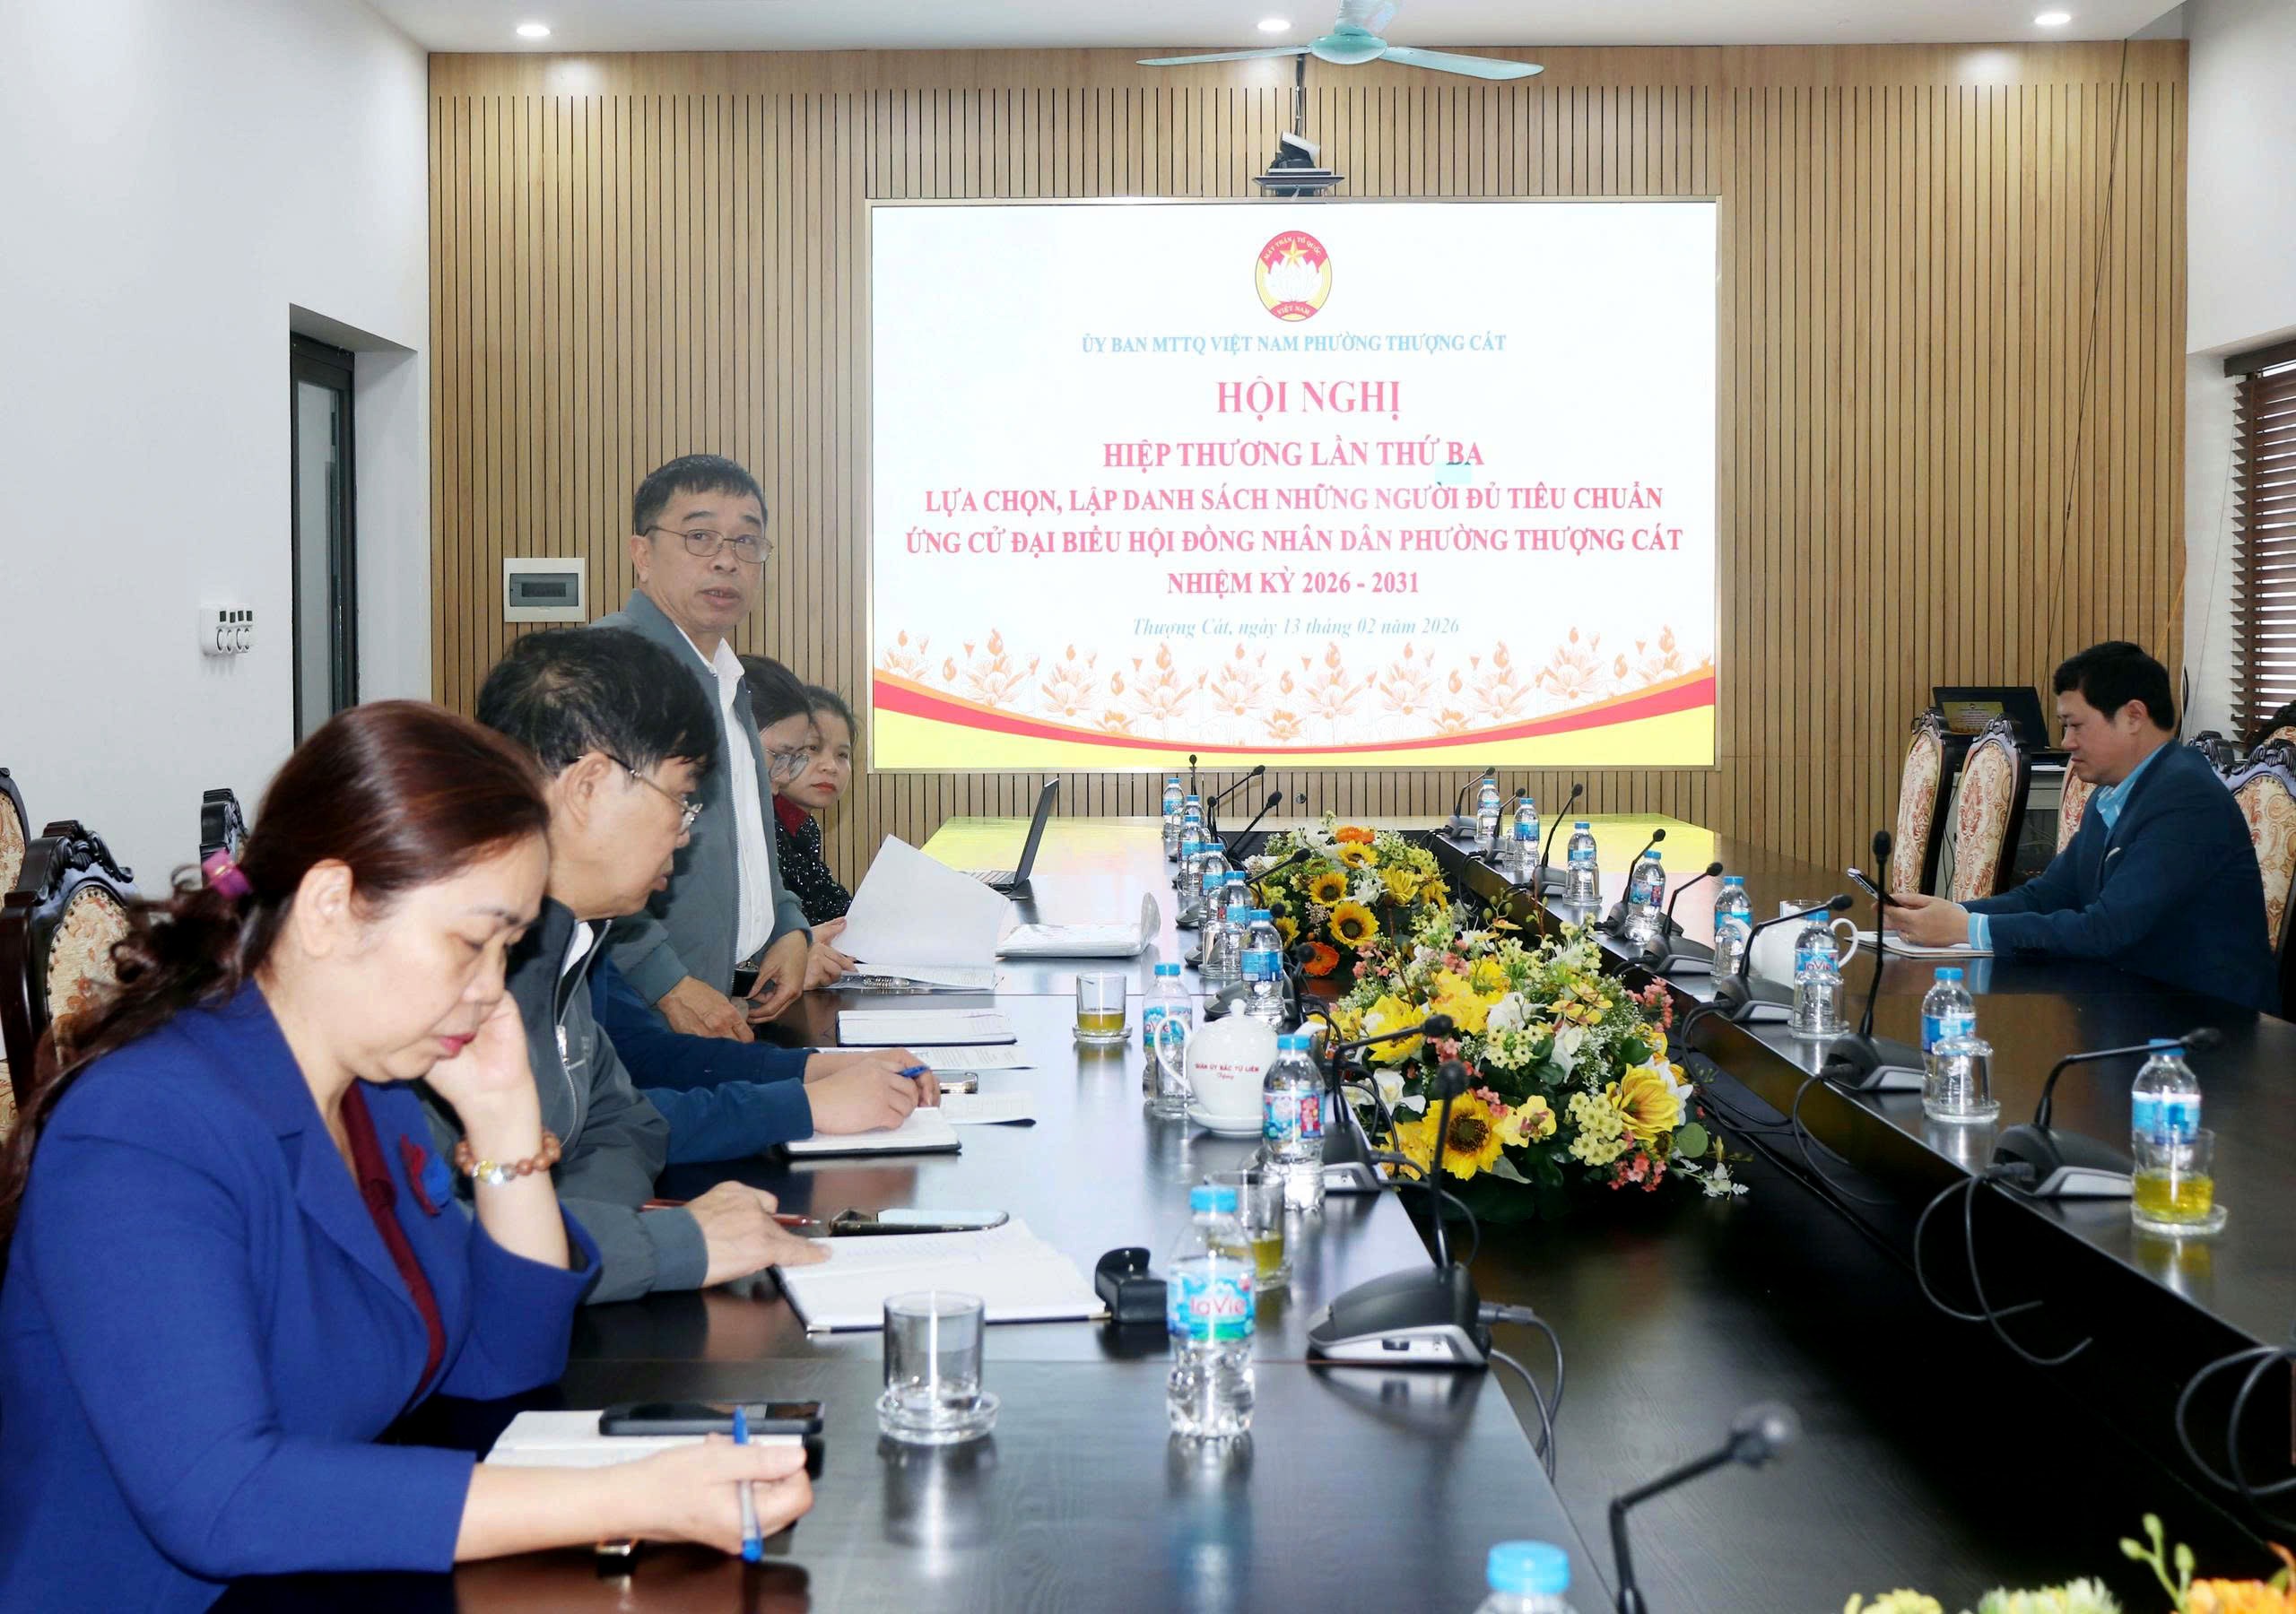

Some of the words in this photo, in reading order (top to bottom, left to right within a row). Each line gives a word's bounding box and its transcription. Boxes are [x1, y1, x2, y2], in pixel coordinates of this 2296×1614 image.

[1082, 333, 1106, 352] ỦY
[1111, 336, 1147, 352] BAN
[1152, 336, 1206, 354] MTTQ
[1211, 334, 1253, 355] VIỆT
[1257, 335, 1300, 351] NAM
[1304, 332, 1381, 352] PHƯỜNG
[1386, 333, 1465, 355] THƯỢNG
[1469, 331, 1507, 351] CÁT
[1217, 376, 1288, 421] HỘI
[1301, 381, 1401, 421] NGHỊ
[1103, 438, 1171, 473] HIỆP
[1177, 438, 1303, 467] THƯƠNG
[1311, 435, 1369, 466] LẦN
[1377, 434, 1440, 466] THỨ
[1445, 441, 1484, 466] BA
[926, 487, 978, 517] LỰA
[983, 490, 1063, 517] CHỌN,
[1070, 486, 1118, 516] LẬP
[1123, 489, 1195, 511] DANH
[1202, 482, 1268, 510] SÁCH
[1275, 483, 1369, 510] NHỮNG
[1375, 482, 1458, 510] NGƯỜI
[1465, 482, 1500, 509] ĐỦ
[1507, 482, 1566, 509] TIÊU
[1573, 481, 1664, 509] CHUẨN
[906, 526, 961, 554] ỨNG
[968, 525, 1006, 553] CỬ
[1011, 531, 1056, 559] ĐẠI
[1062, 525, 1121, 553] BIỂU
[1128, 527, 1174, 558] HỘI
[1182, 525, 1255, 552] ĐỒNG
[1262, 524, 1333, 551] NHÂN
[1340, 524, 1392, 551] DÂN
[1399, 524, 1509, 551] PHƯỜNG
[1514, 525, 1625, 556] THƯỢNG
[1631, 523, 1684, 551] CÁT
[1167, 569, 1253, 599] NHIỆM
[1260, 566, 1296, 594] KỲ
[1302, 572, 1351, 594] 2026
[1371, 571, 1420, 593] 2031
[1133, 617, 1196, 638] Thượng
[1238, 620, 1277, 639] ngày
[1283, 618, 1301, 633] 13
[1306, 618, 1352, 638] tháng
[1356, 617, 1377, 634] 02
[1380, 619, 1417, 635] năm
[1422, 617, 1460, 634] 2026
